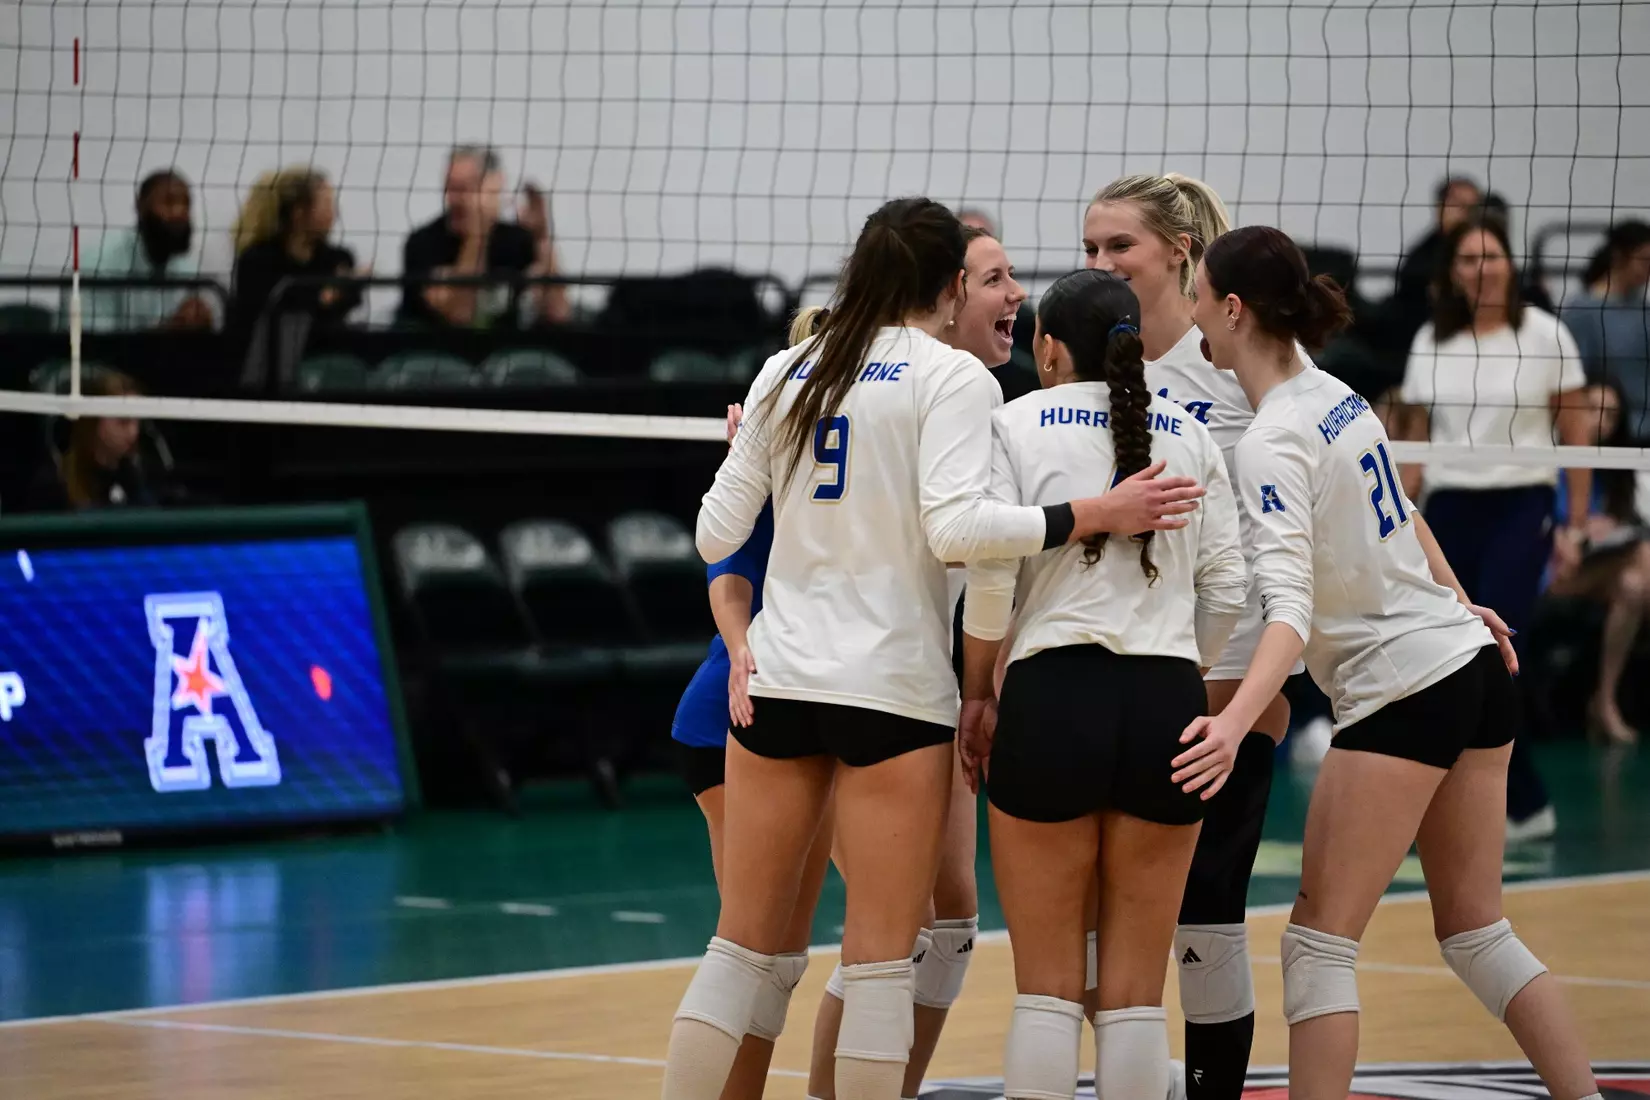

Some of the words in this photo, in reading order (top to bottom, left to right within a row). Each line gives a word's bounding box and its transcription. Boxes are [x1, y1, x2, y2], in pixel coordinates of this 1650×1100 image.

[810, 411, 853, 504] 9
[1040, 407, 1182, 436] HURRNE
[1357, 438, 1410, 543] 21
